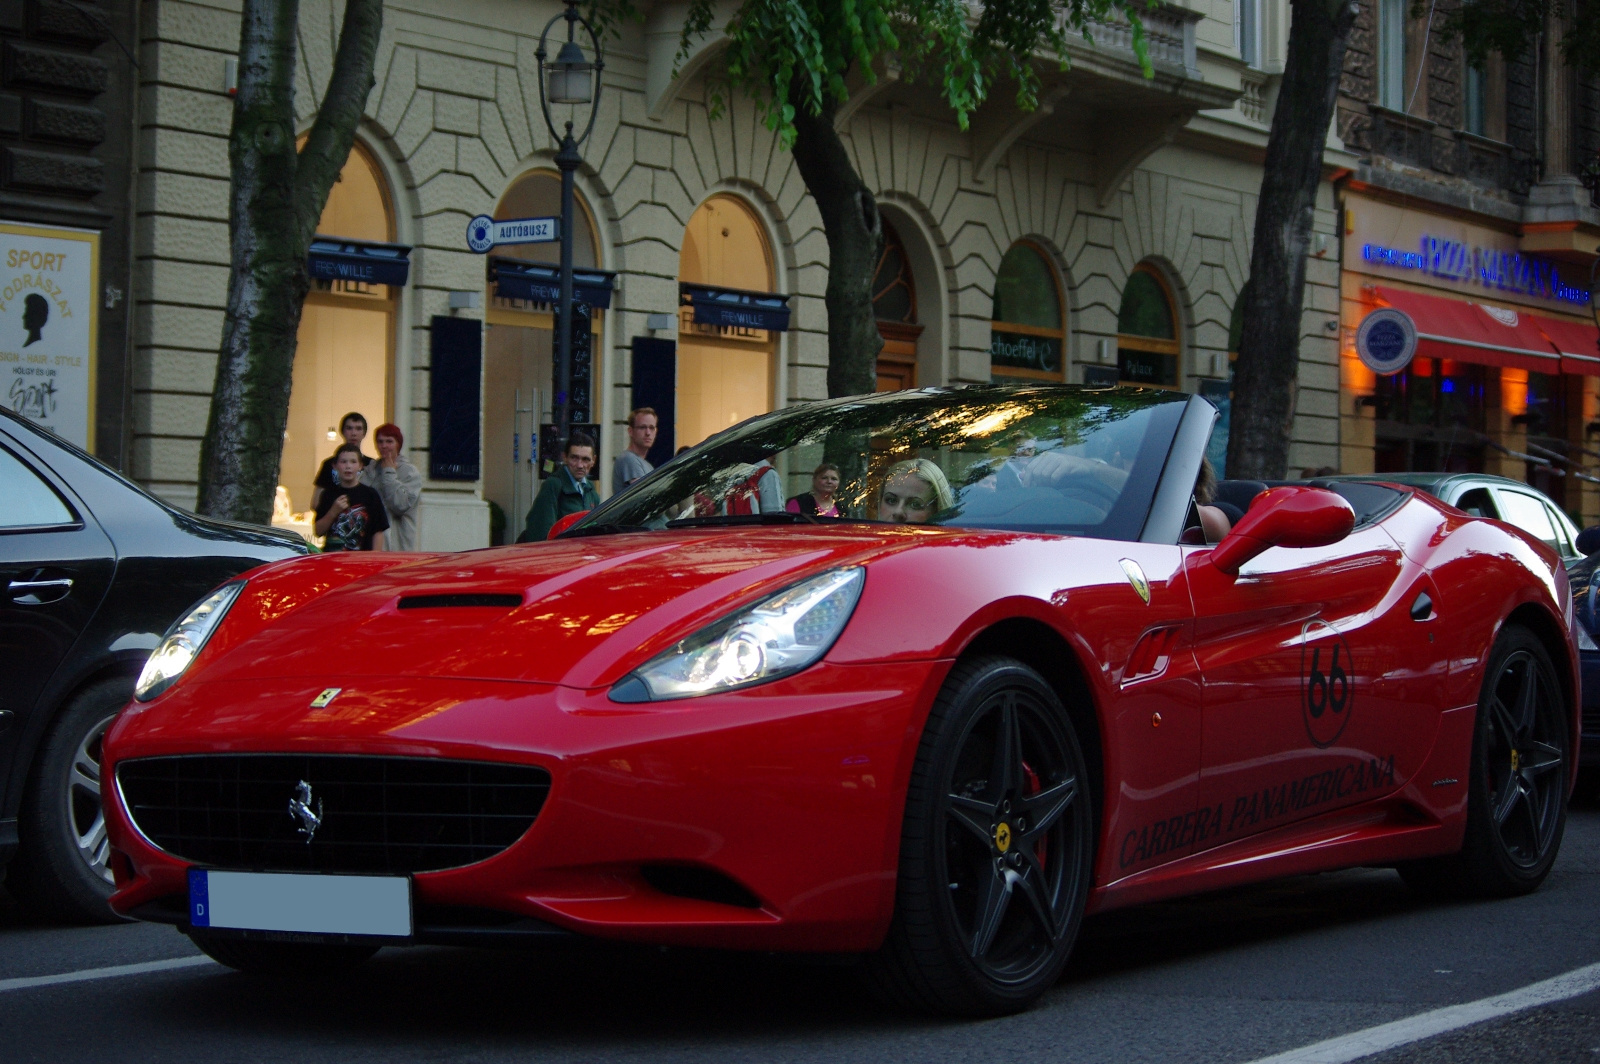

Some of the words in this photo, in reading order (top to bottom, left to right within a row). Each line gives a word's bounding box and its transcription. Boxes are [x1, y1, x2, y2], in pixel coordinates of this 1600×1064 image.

[500, 222, 547, 238] AUTÓBUSZ
[6, 248, 66, 272] SPORT
[315, 260, 373, 278] FREYWILLE
[0, 271, 73, 319] FODRÁSZAT
[27, 354, 48, 364] HAIR
[54, 355, 81, 367] STYLE
[1127, 359, 1153, 376] Palace
[1308, 643, 1348, 719] 66
[1119, 804, 1222, 868] CARRERA
[1227, 755, 1394, 830] PANAMERICANA
[196, 903, 204, 916] D
